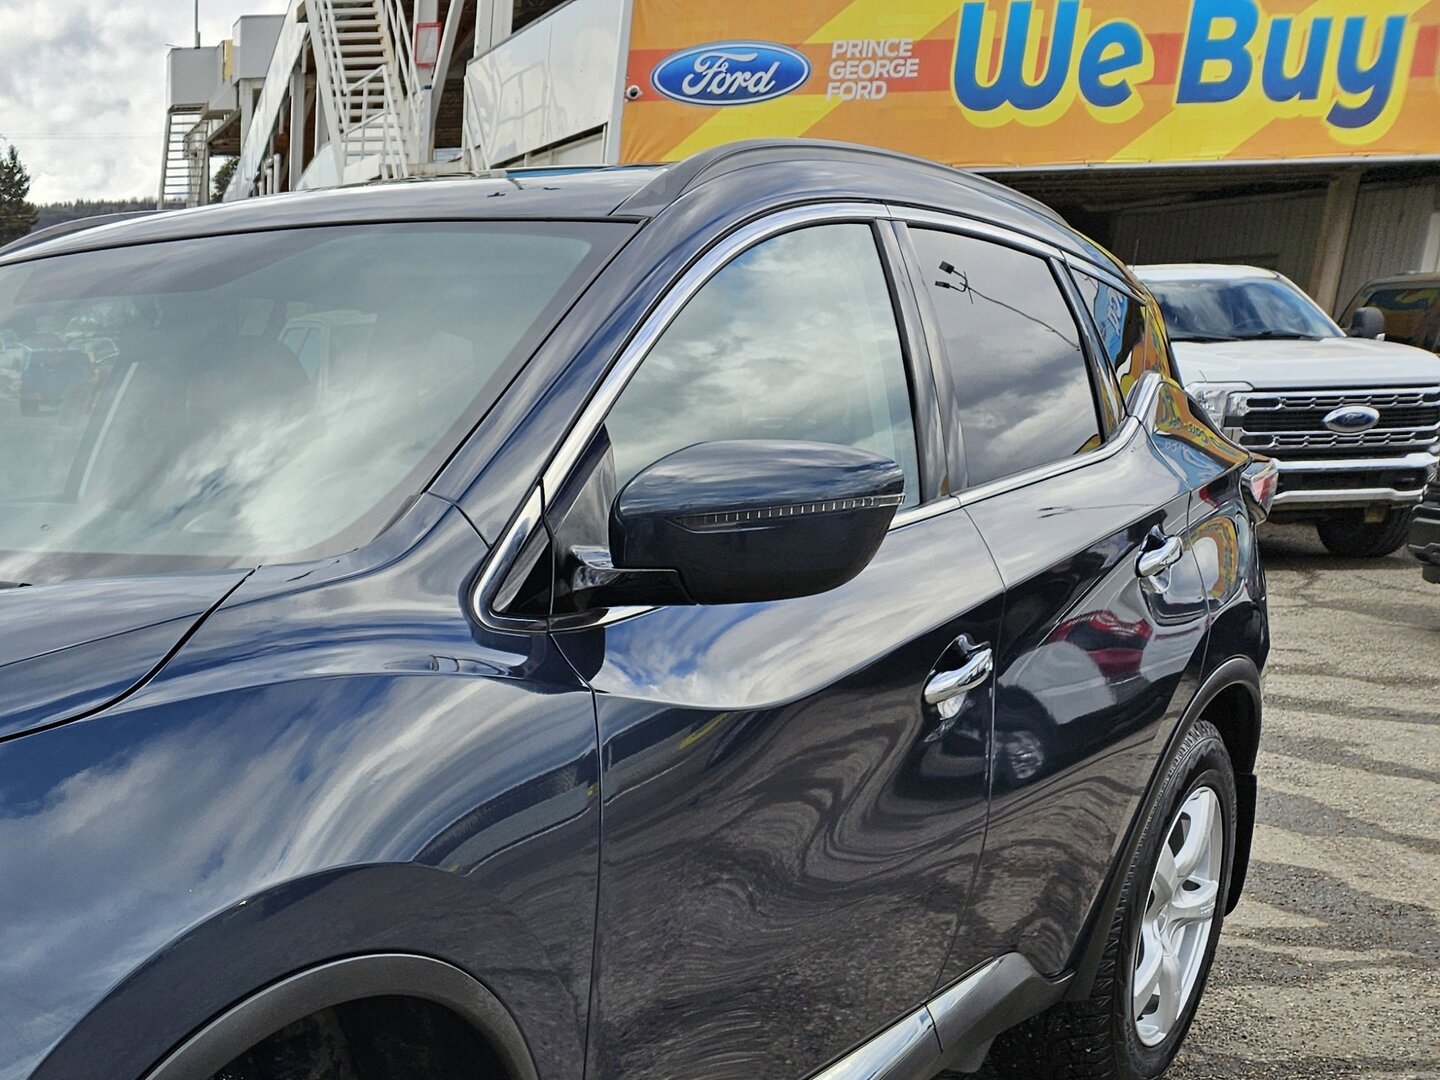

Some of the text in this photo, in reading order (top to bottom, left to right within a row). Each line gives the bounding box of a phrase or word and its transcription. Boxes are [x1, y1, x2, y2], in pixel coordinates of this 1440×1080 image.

[831, 38, 913, 59] PRINCE
[681, 51, 781, 95] Ford
[828, 58, 920, 80] GEORGE
[954, 0, 1409, 130] We Buy
[825, 80, 887, 101] FORD
